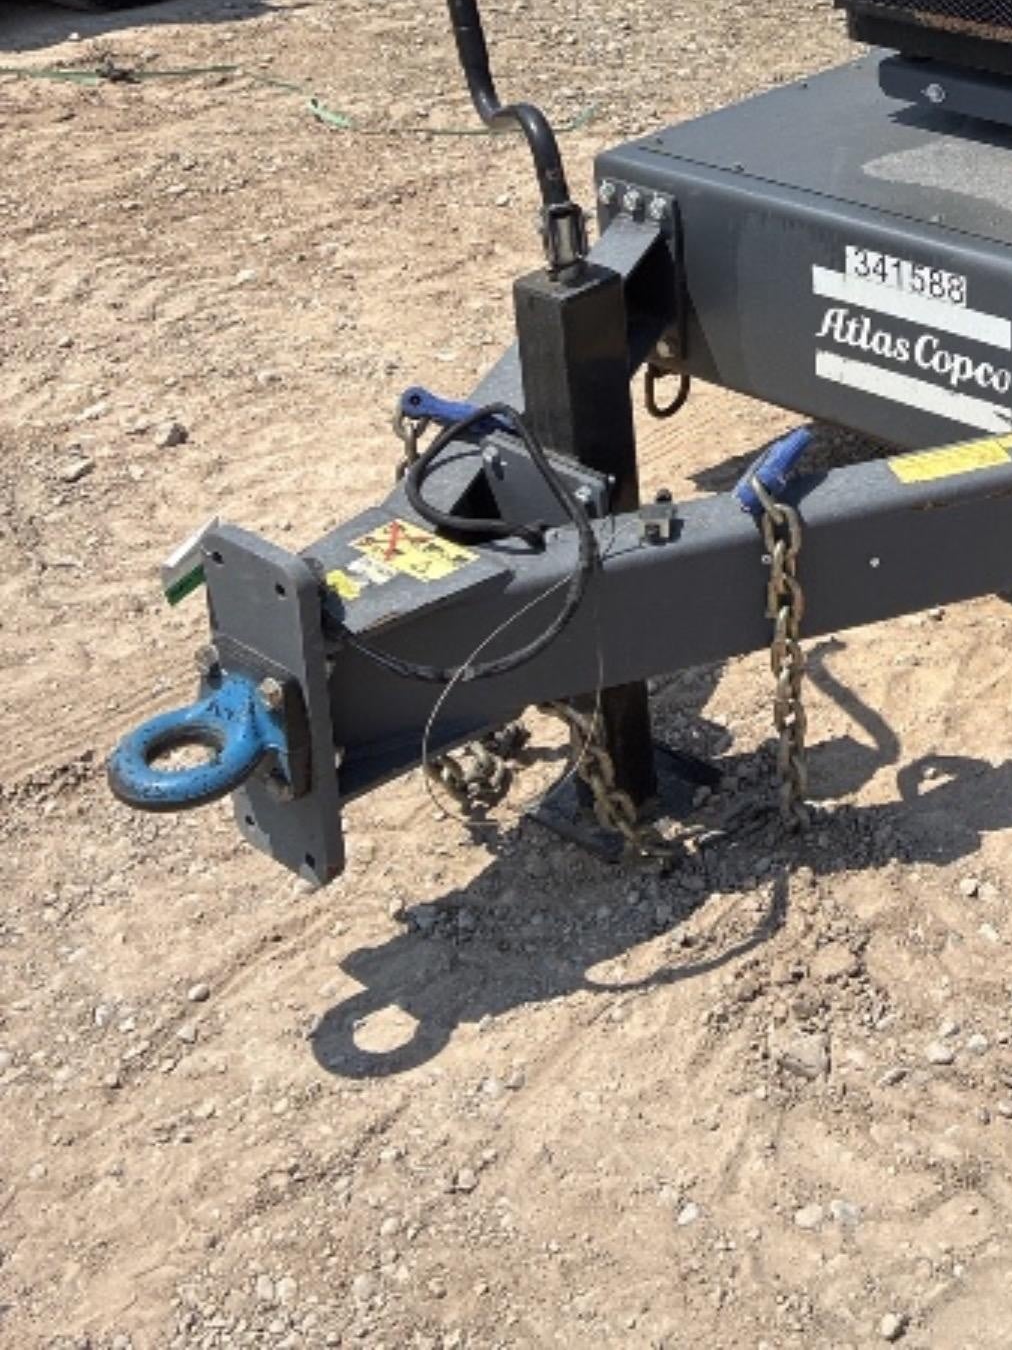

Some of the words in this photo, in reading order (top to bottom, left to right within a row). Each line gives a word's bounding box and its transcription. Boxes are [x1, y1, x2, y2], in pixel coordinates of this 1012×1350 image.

[852, 248, 965, 305] 341588
[815, 307, 910, 361] Atlas
[914, 334, 1012, 394] Copco
